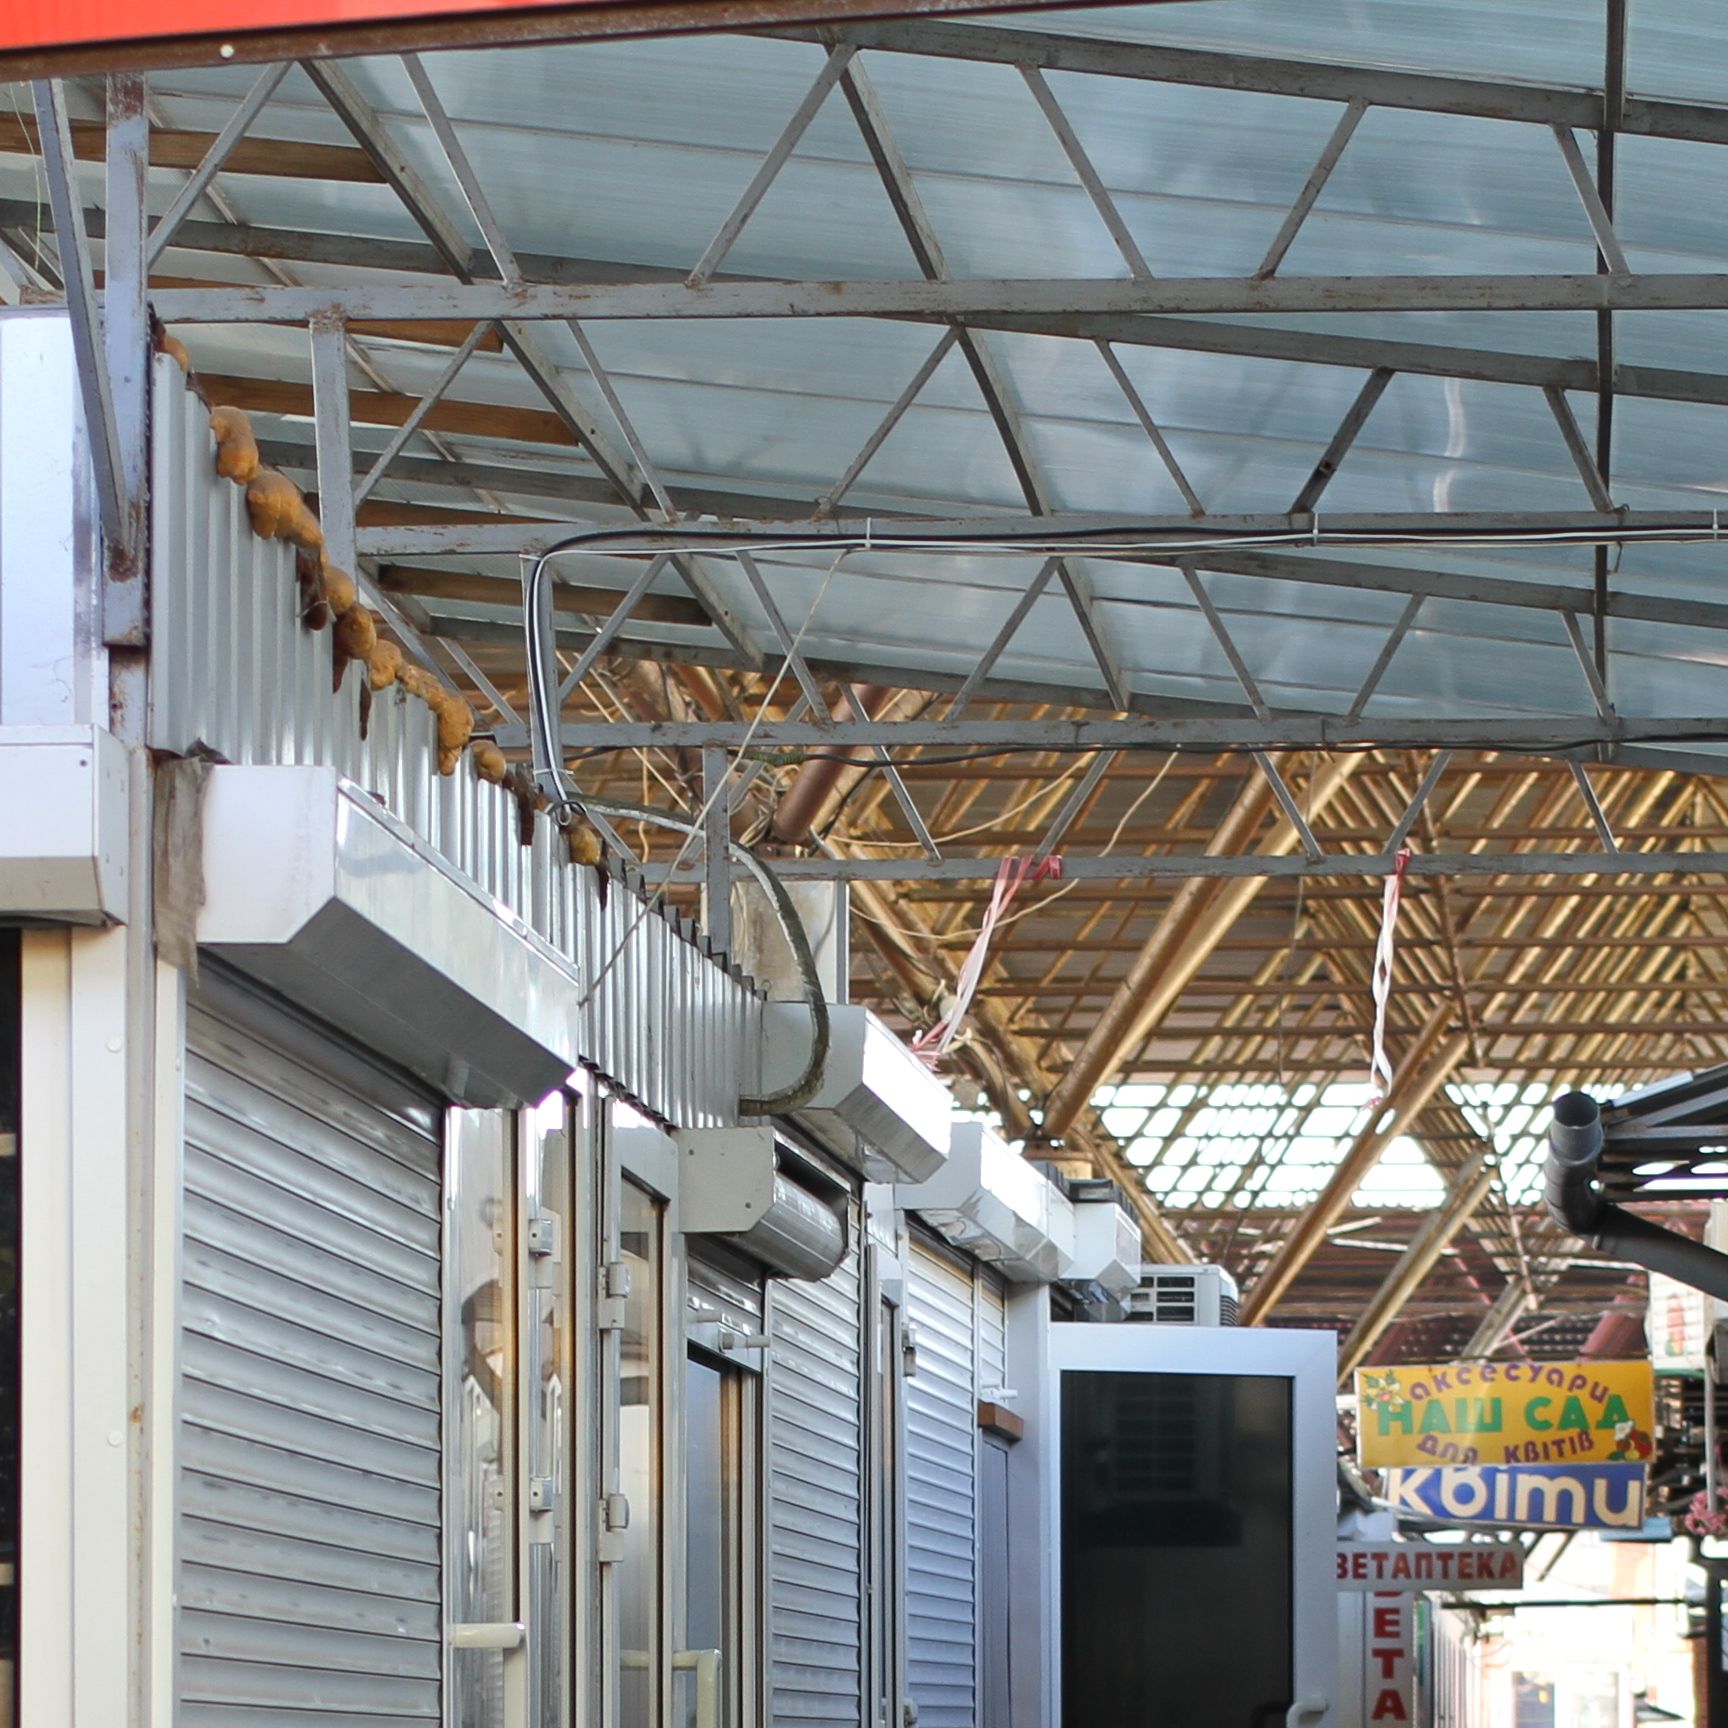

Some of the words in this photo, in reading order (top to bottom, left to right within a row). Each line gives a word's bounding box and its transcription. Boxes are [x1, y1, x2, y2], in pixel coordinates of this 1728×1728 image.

[1409, 1363, 1610, 1404] аксесуари
[1377, 1396, 1503, 1437] НАШ
[1525, 1393, 1631, 1432] САД
